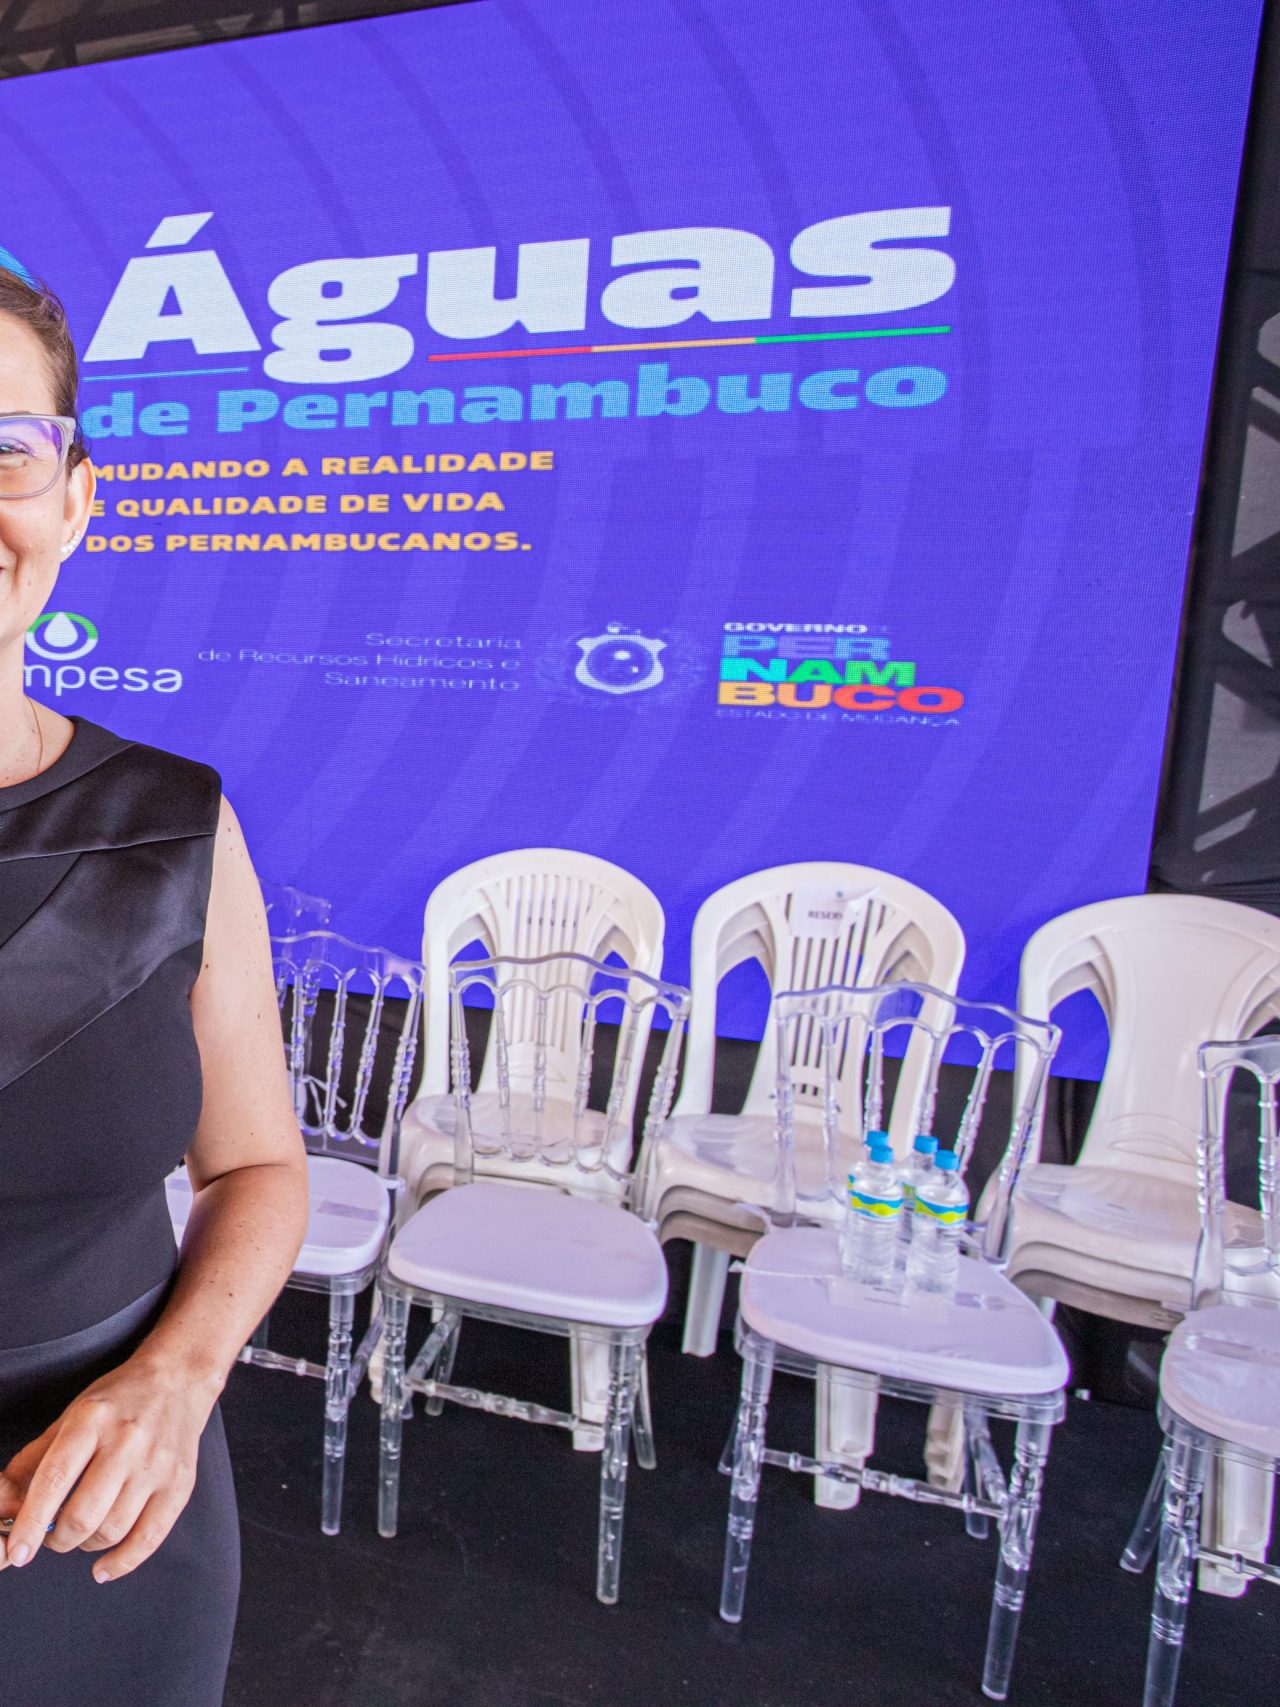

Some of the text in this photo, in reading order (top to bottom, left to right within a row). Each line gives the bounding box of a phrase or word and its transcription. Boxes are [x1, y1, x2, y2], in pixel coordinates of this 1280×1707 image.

[81, 207, 956, 385] Águas
[82, 364, 948, 440] de Pernambuco
[94, 450, 554, 481] MUDANDO A REALIDADE
[116, 494, 328, 518] QUALIDADE
[338, 494, 392, 514] DE
[402, 492, 505, 512] VIDA
[86, 530, 532, 553] DOS PERNAMBUCANOS.
[365, 632, 522, 650] Secretaria
[723, 621, 868, 634] GOVERNO
[198, 648, 232, 662] de
[239, 648, 368, 666] Recursos
[500, 659, 520, 670] e
[722, 634, 891, 661] PER
[24, 664, 184, 697] mpesa
[324, 671, 520, 691] Saneamento
[720, 657, 916, 687] NAM
[717, 681, 964, 713] BUCO
